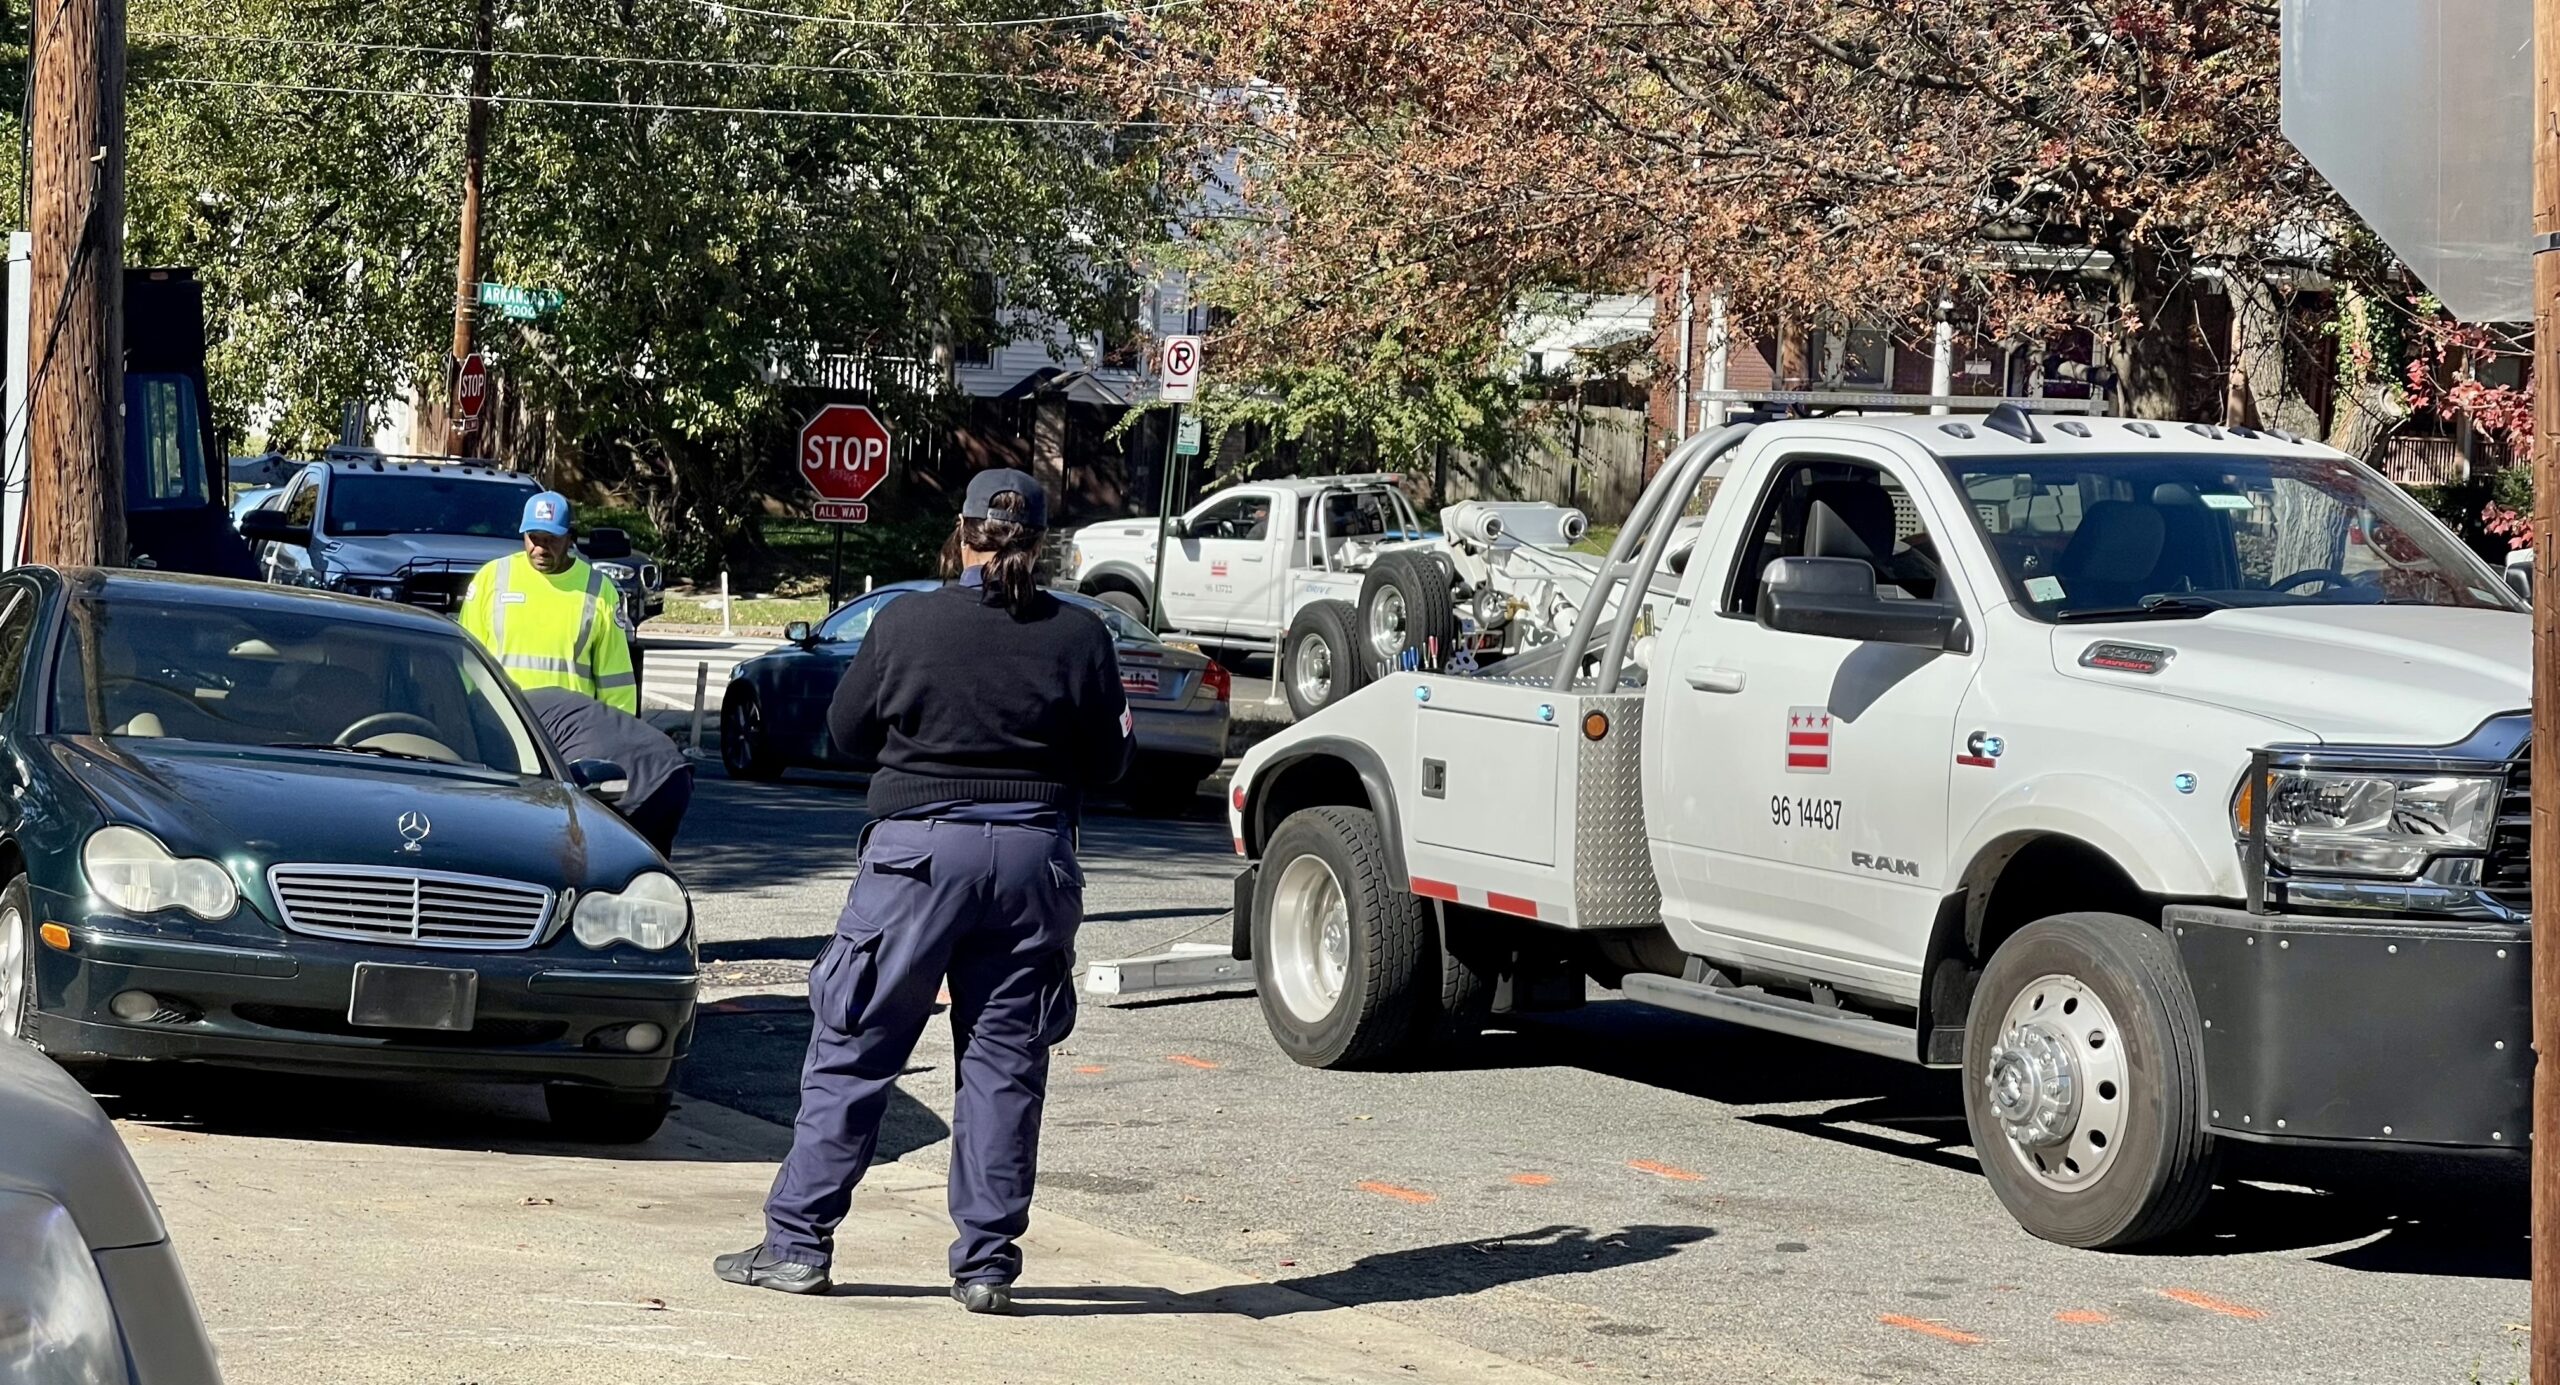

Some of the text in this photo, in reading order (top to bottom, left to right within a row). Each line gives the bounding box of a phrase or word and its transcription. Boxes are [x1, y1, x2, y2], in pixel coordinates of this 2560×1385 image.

[483, 286, 546, 308] ARKANSAS
[504, 304, 536, 317] 5000
[461, 374, 484, 398] STOP
[806, 435, 883, 471] STOP
[819, 506, 862, 519] ALL WAY
[1771, 795, 1842, 830] 96 14487
[1851, 851, 1920, 878] RAM
